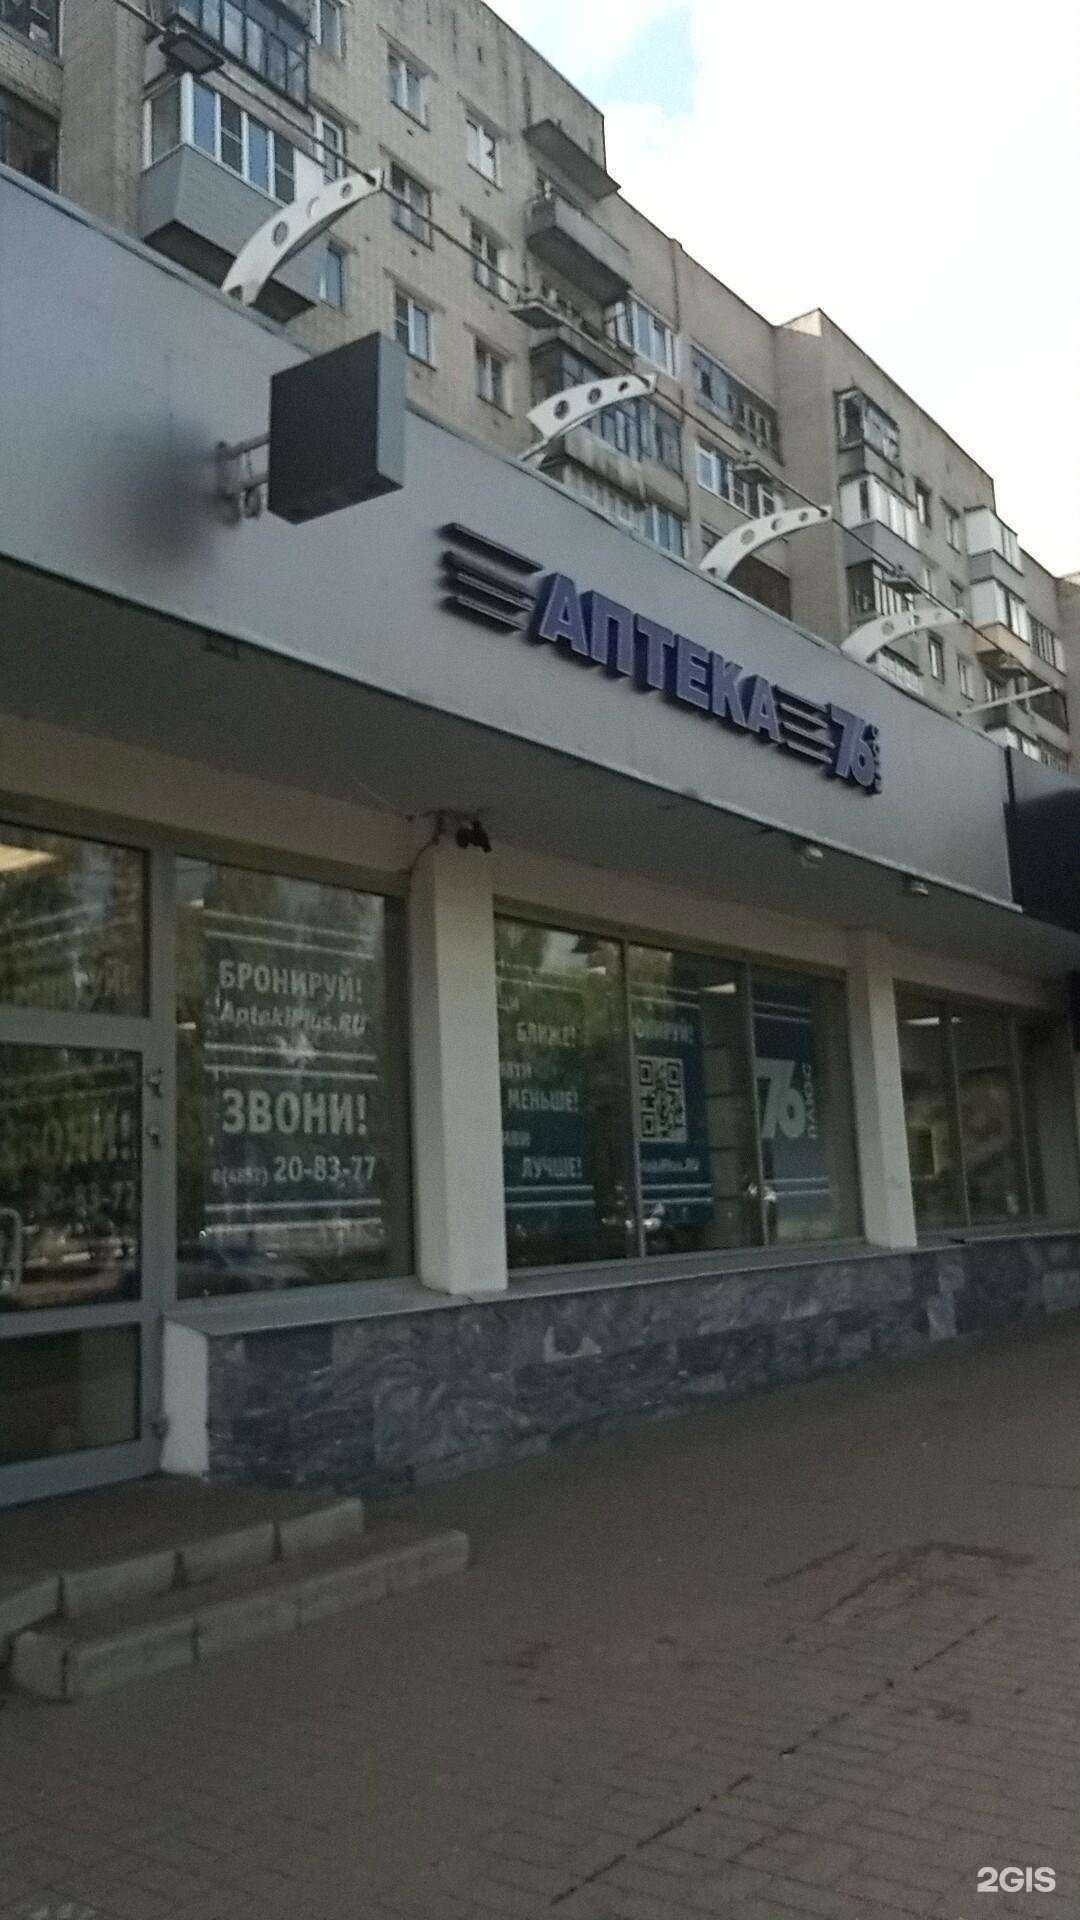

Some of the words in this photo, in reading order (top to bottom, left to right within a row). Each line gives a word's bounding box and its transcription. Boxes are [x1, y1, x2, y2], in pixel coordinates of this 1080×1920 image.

[532, 572, 783, 743] АПТЕКА
[826, 702, 877, 789] 76
[218, 957, 362, 1005] БРОНИРУЙ!
[222, 1088, 369, 1136] ЗВОНИ!
[273, 1154, 376, 1183] 20-83-77
